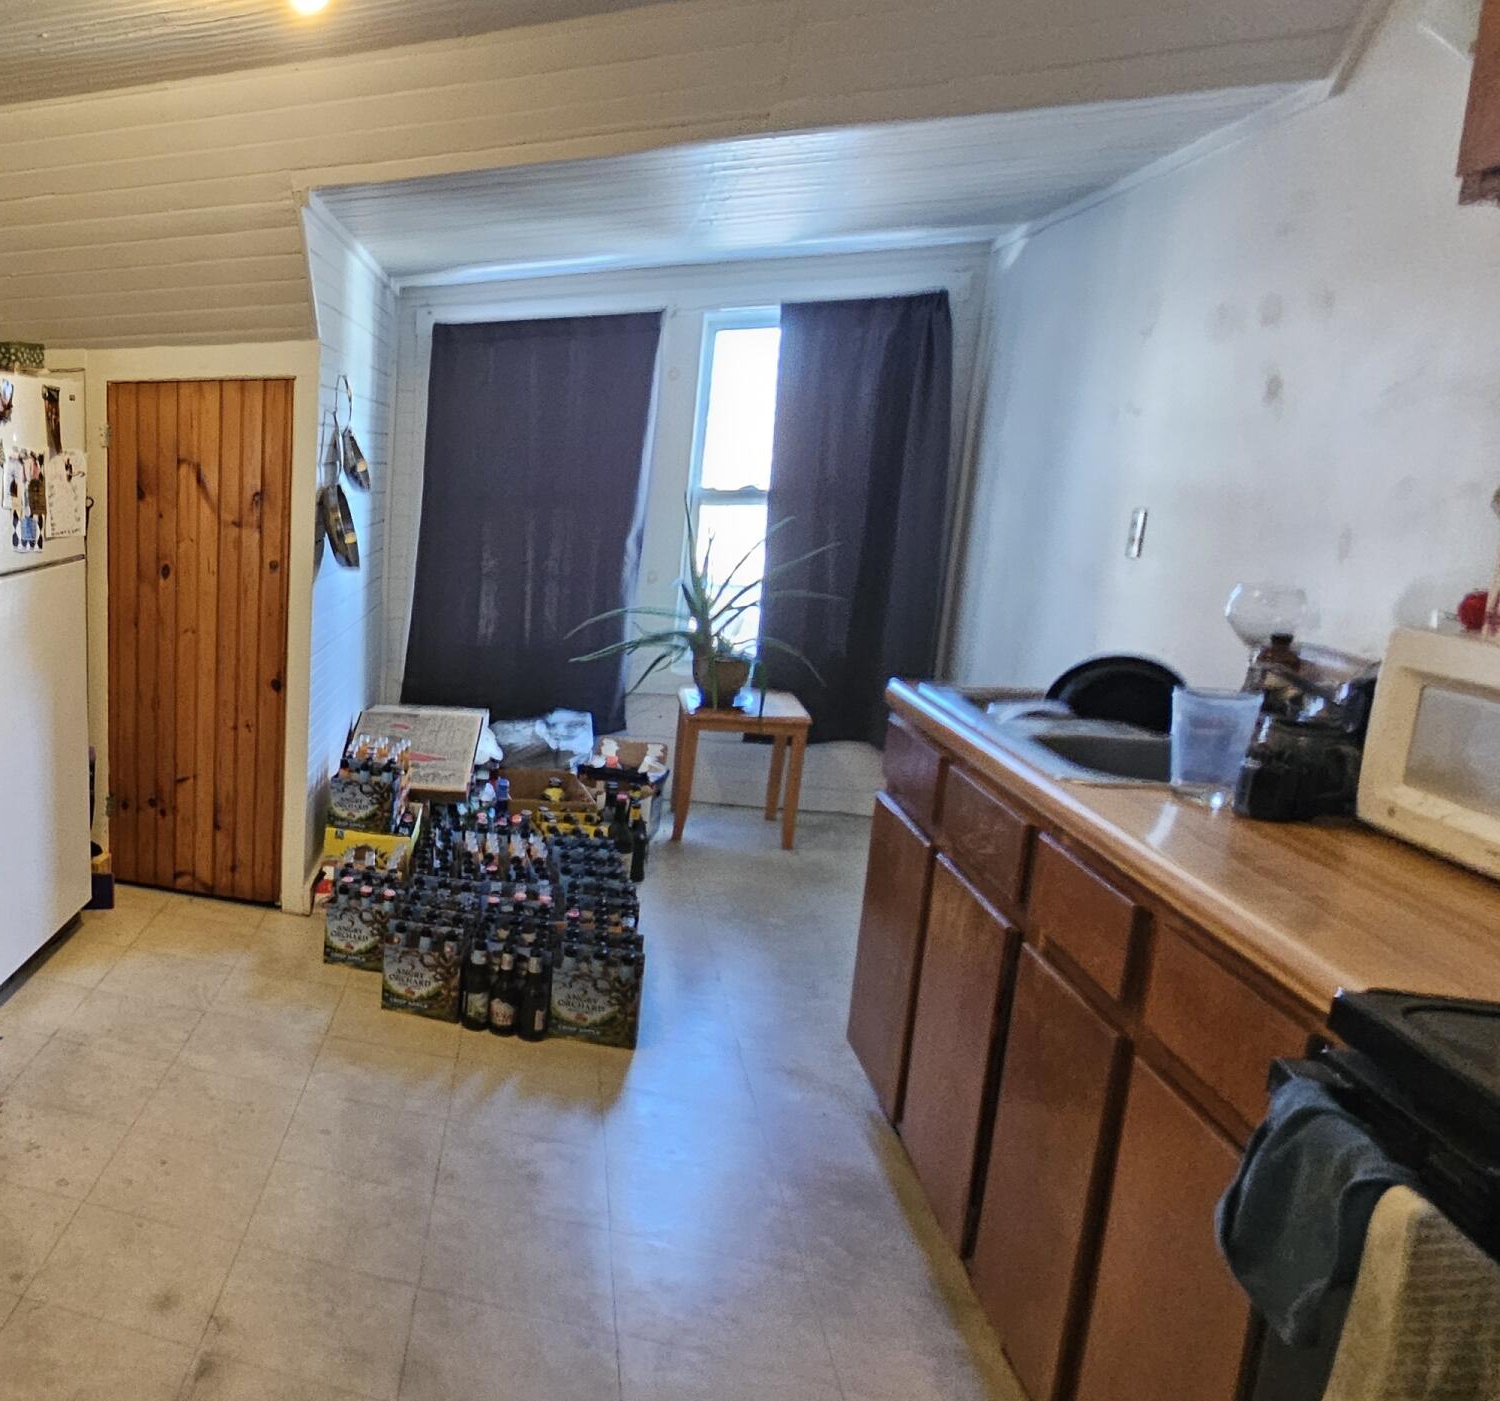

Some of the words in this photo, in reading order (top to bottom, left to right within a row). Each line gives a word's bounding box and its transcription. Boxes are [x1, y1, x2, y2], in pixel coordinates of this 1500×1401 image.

[394, 967, 424, 979] ANGRY
[388, 973, 431, 988] ORCHARD
[564, 992, 599, 1005] ANGRY
[557, 999, 606, 1014] ORCHARD
